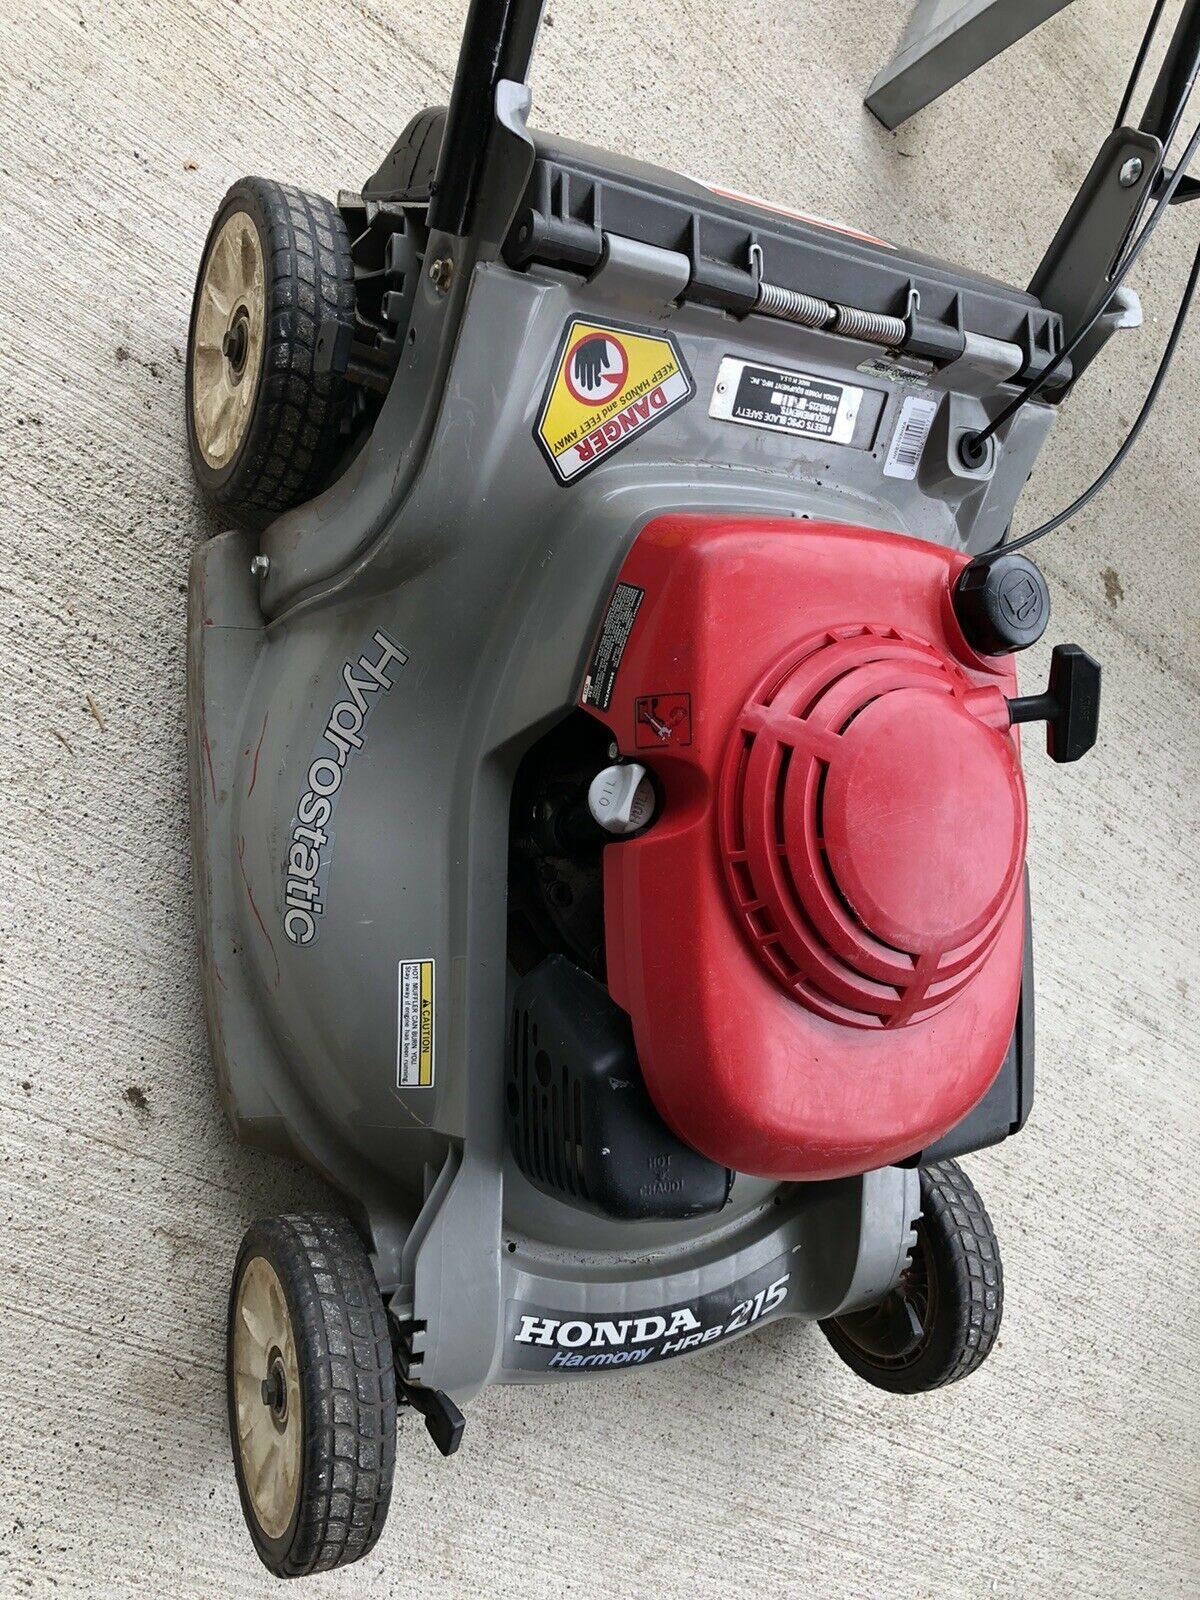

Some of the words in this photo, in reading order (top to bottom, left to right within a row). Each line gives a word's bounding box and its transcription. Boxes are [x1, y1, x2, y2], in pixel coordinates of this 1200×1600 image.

[652, 362, 674, 382] KEEP
[621, 380, 651, 405] HANDS
[603, 402, 619, 419] and
[735, 406, 763, 420] SAFETY
[764, 411, 787, 425] BLADE
[573, 386, 668, 462] DANGER
[580, 412, 602, 434] FEET
[787, 418, 805, 429] CPSC
[806, 422, 828, 433] MEETS
[553, 429, 578, 453] AWAY
[283, 630, 410, 944] Hydrostatic
[599, 781, 618, 807] OIL
[403, 966, 411, 980] Stay
[411, 965, 419, 979] HOT
[411, 983, 419, 1013] MUFFLER
[411, 1015, 419, 1029] CAN
[422, 1010, 431, 1053] CAUTION
[514, 1307, 701, 1348] HONDA
[549, 1347, 655, 1368] Harmony
